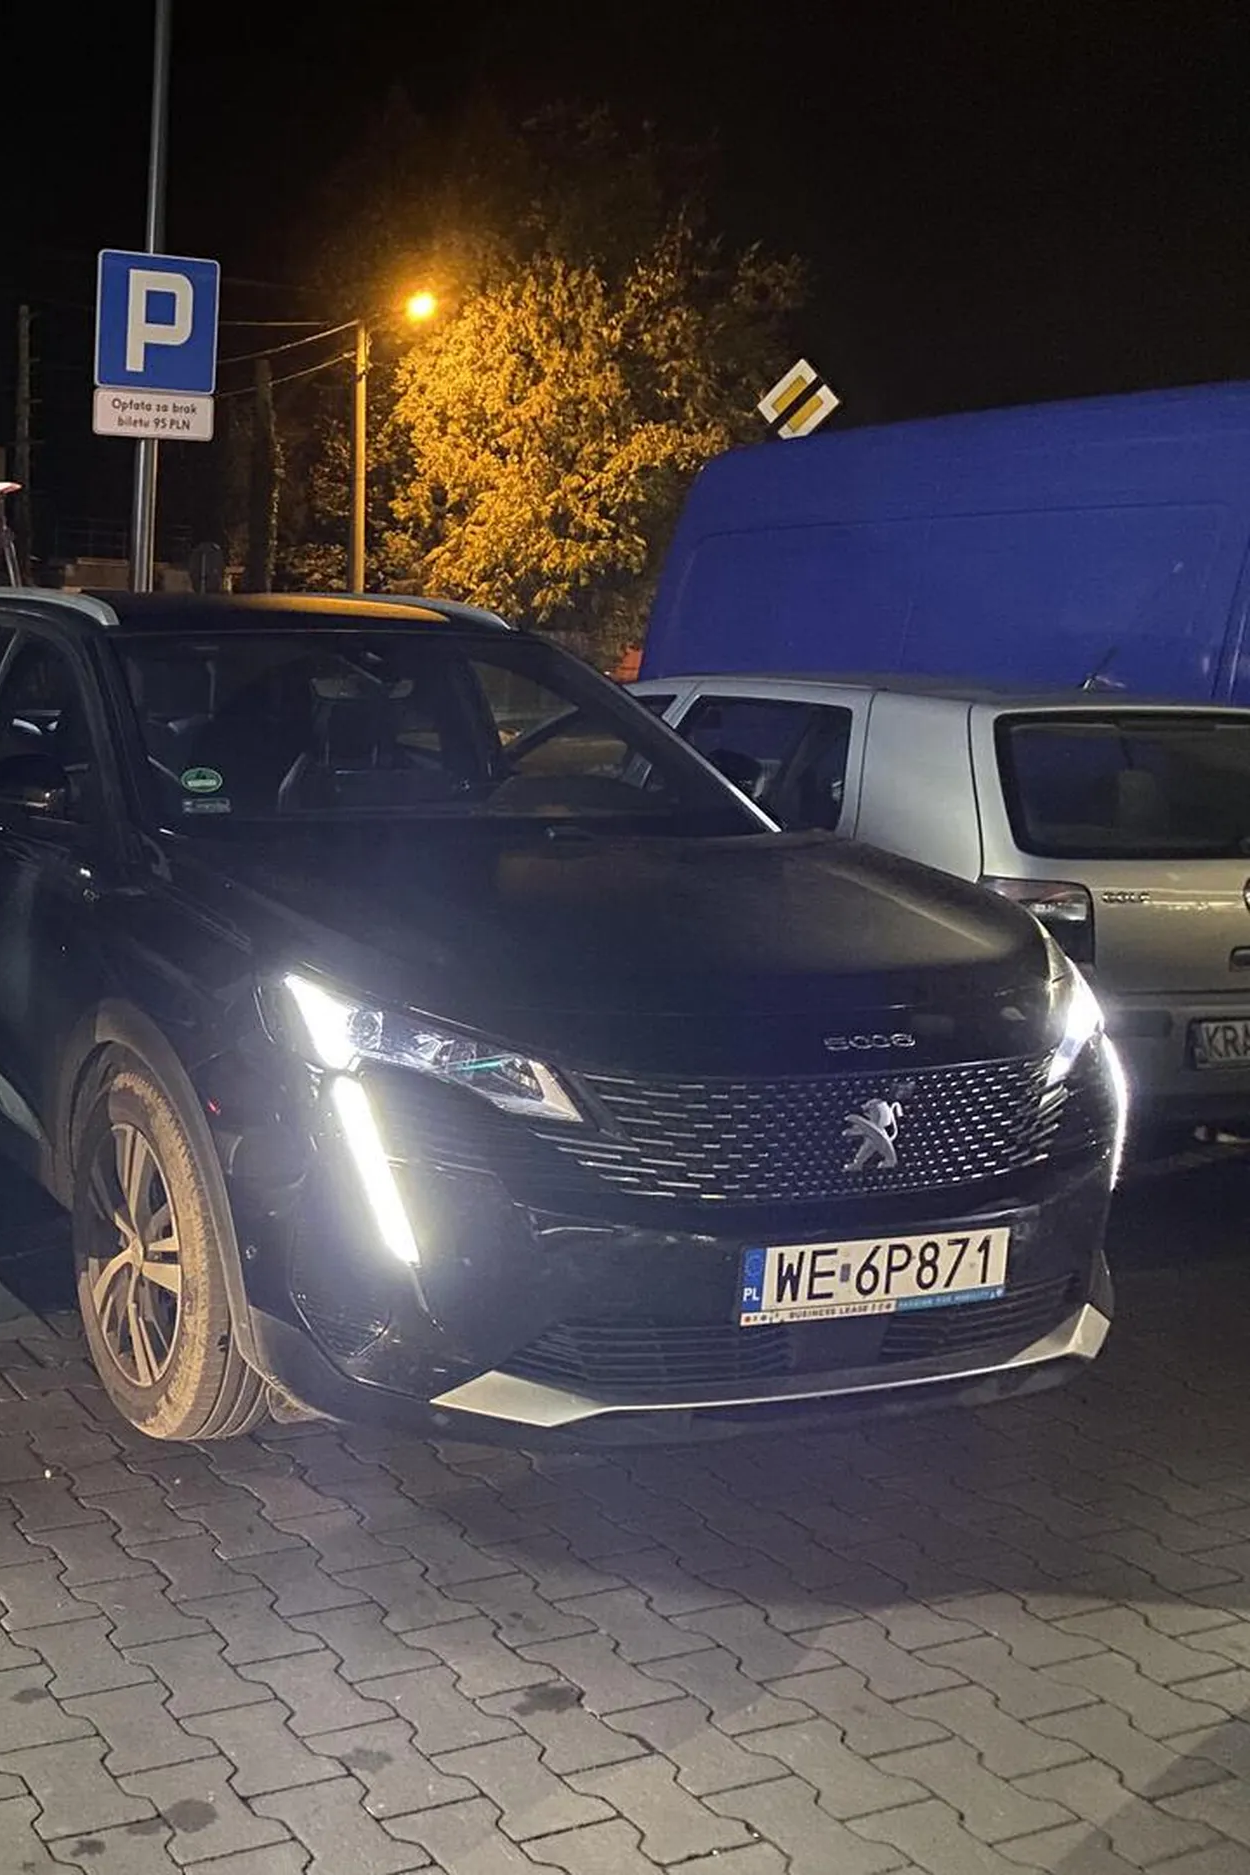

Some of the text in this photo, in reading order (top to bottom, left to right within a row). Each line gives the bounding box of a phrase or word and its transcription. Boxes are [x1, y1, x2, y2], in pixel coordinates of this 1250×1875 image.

[125, 268, 194, 372] P
[172, 403, 197, 415] brak
[117, 416, 191, 430] biletu 95 PLN
[823, 1033, 916, 1050] 5008
[775, 1235, 992, 1303] WE 6P871
[743, 1287, 760, 1302] PL
